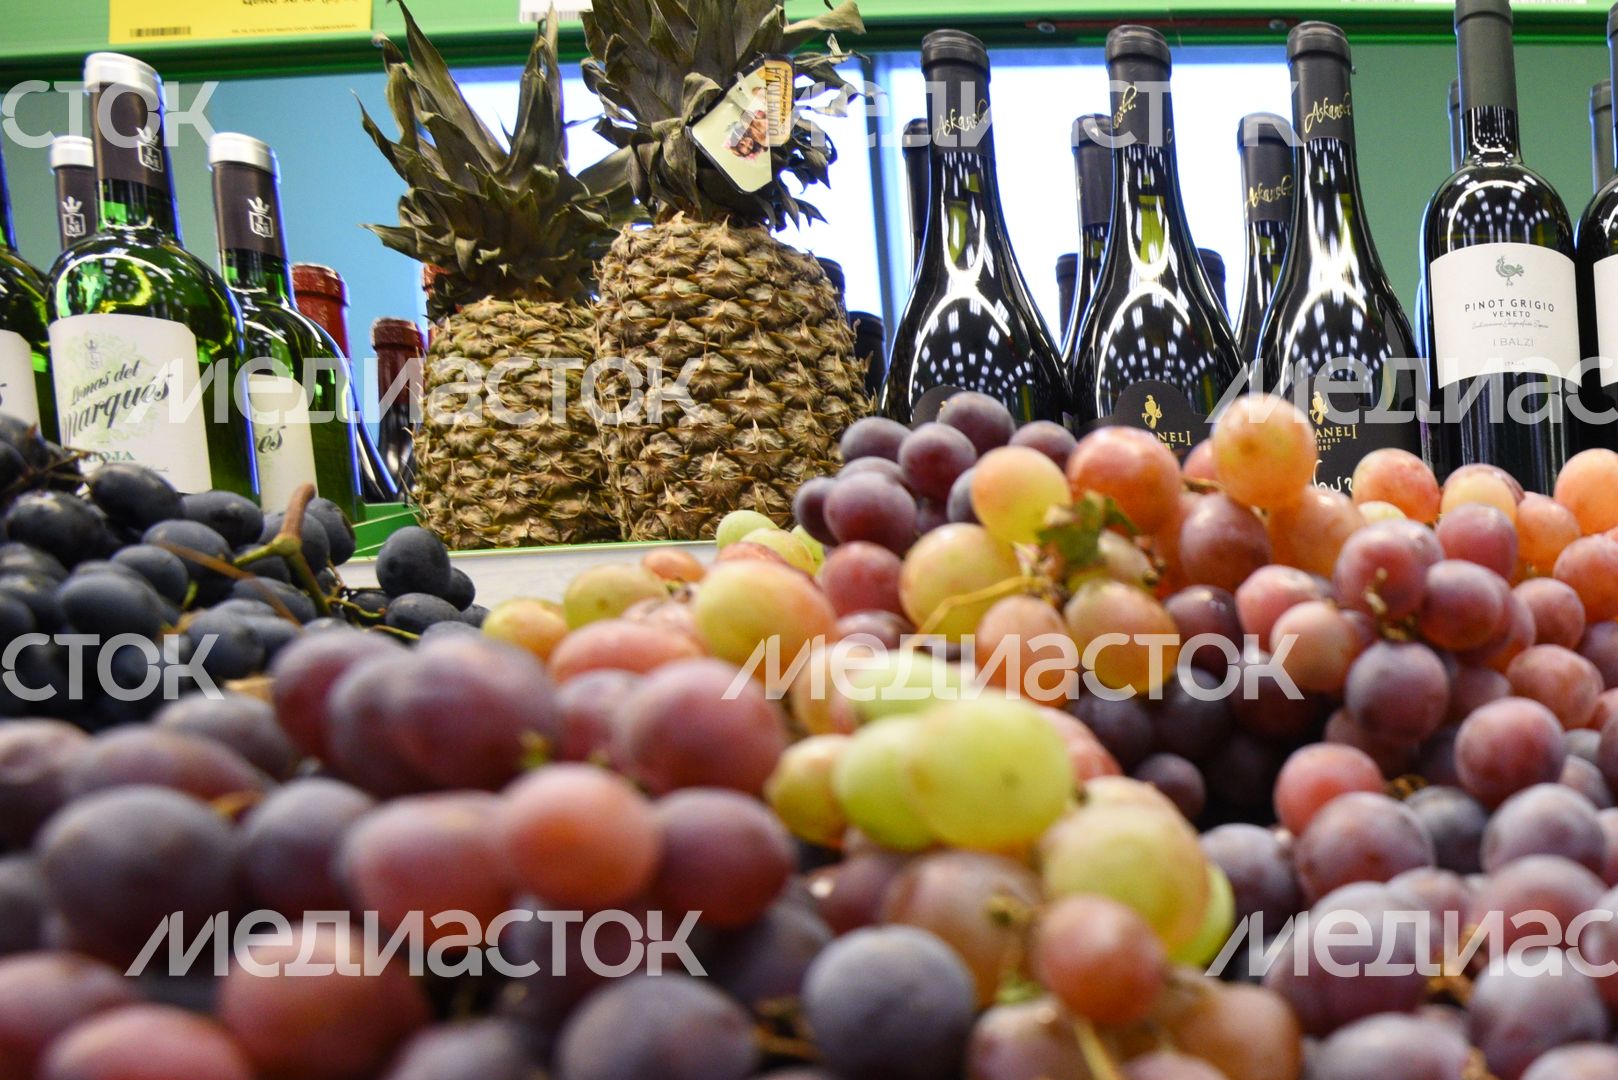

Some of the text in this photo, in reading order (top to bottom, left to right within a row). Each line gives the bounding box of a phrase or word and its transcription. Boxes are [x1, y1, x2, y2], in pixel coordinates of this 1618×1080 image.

[1464, 298, 1555, 313] PINOT GRIGIO
[1492, 310, 1531, 318] VENETO
[1500, 337, 1534, 347] BALZI
[114, 359, 140, 382] del
[1157, 430, 1192, 446] NELI
[1315, 424, 1357, 439] ANELI
